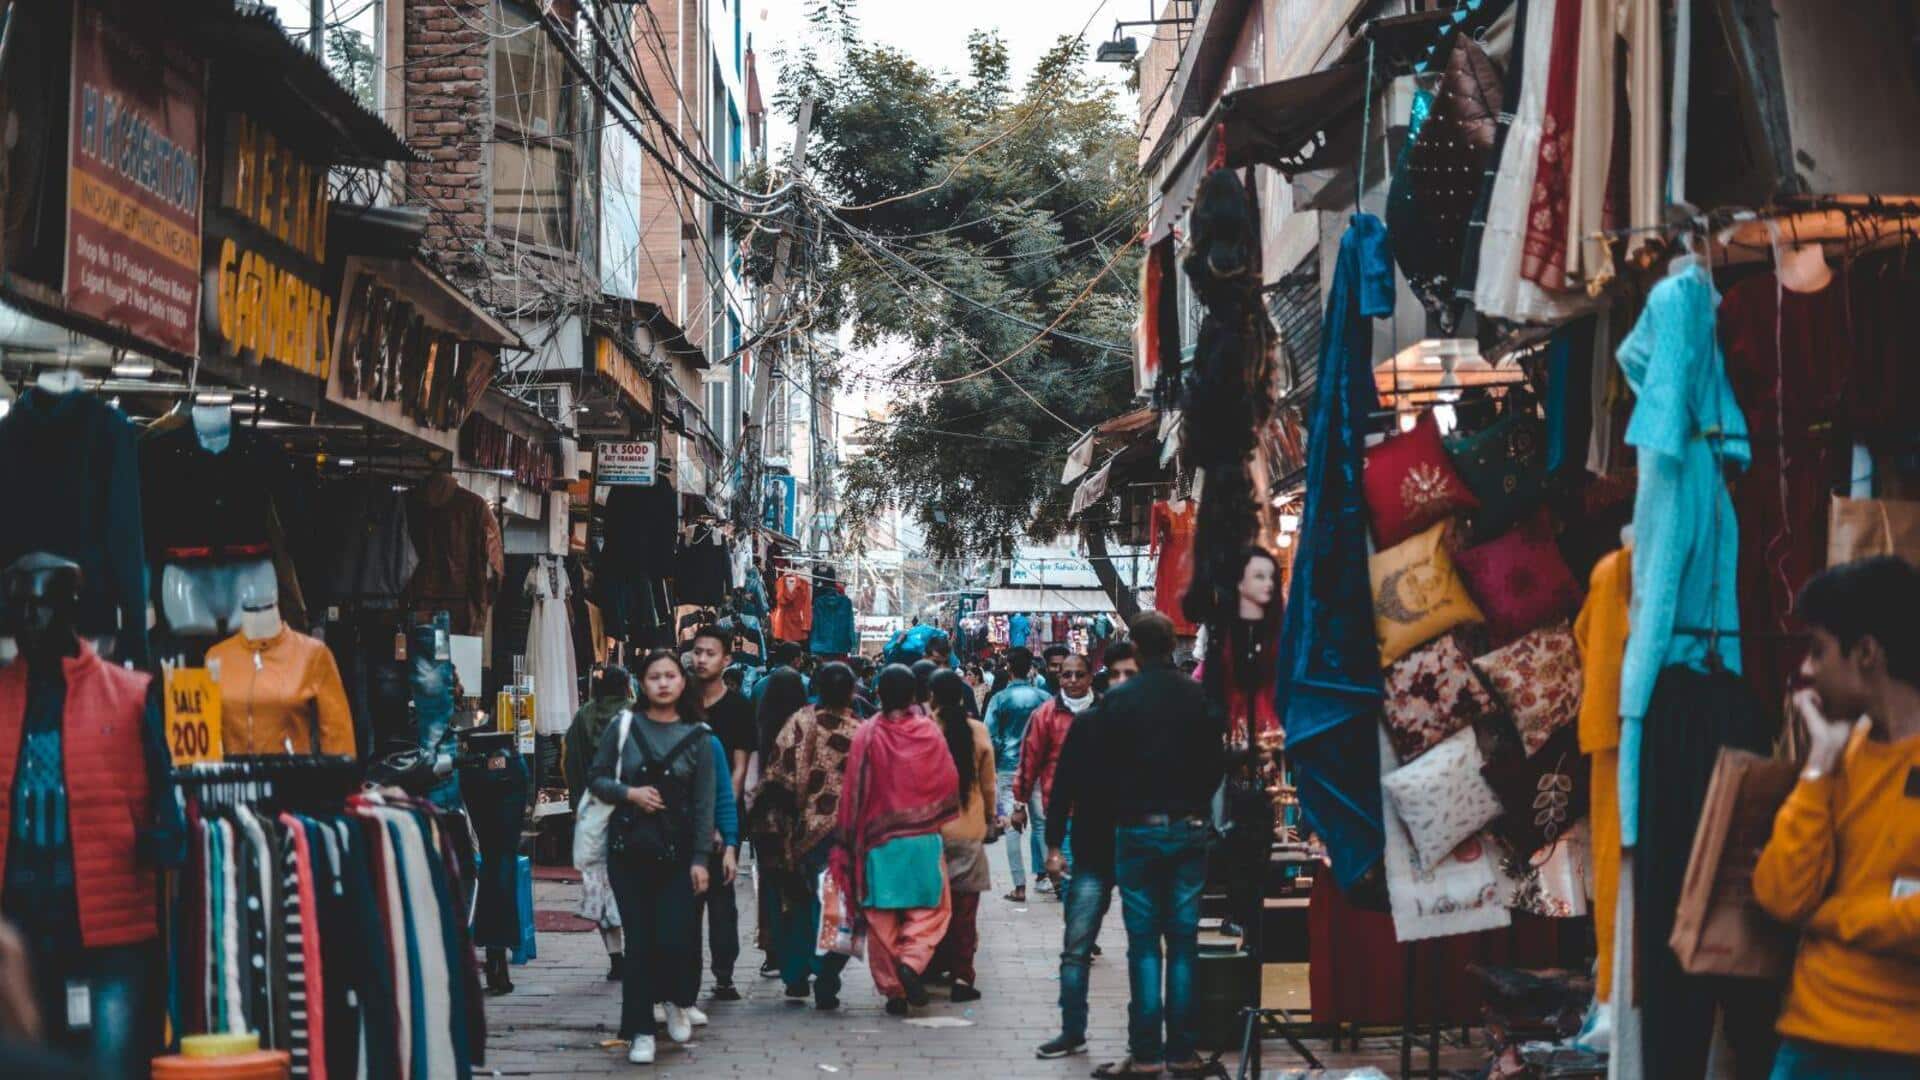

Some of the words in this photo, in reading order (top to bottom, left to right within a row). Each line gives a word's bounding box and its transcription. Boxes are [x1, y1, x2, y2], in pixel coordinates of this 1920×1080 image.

[119, 104, 198, 217] CREATION
[77, 233, 97, 264] Shop
[218, 237, 332, 381] GARMENTS
[611, 445, 618, 454] K
[622, 444, 649, 455] SOOD
[173, 689, 202, 714] SALE
[173, 721, 209, 757] 200
